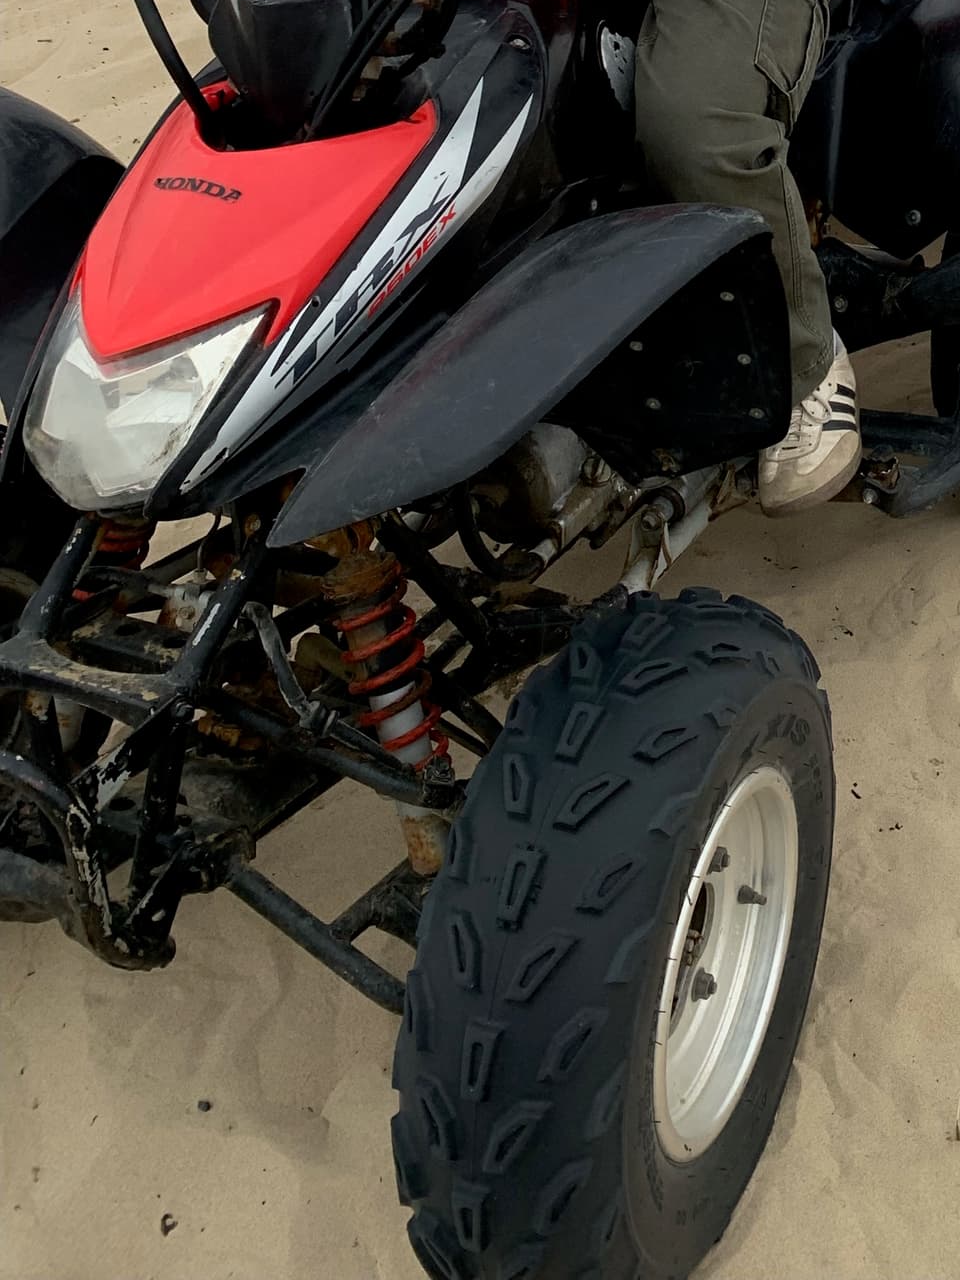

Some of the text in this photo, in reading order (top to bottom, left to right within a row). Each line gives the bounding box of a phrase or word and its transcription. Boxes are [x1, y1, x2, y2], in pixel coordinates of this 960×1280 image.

[154, 177, 242, 202] HONDA
[274, 175, 452, 389] TRX
[367, 200, 457, 319] 250EX
